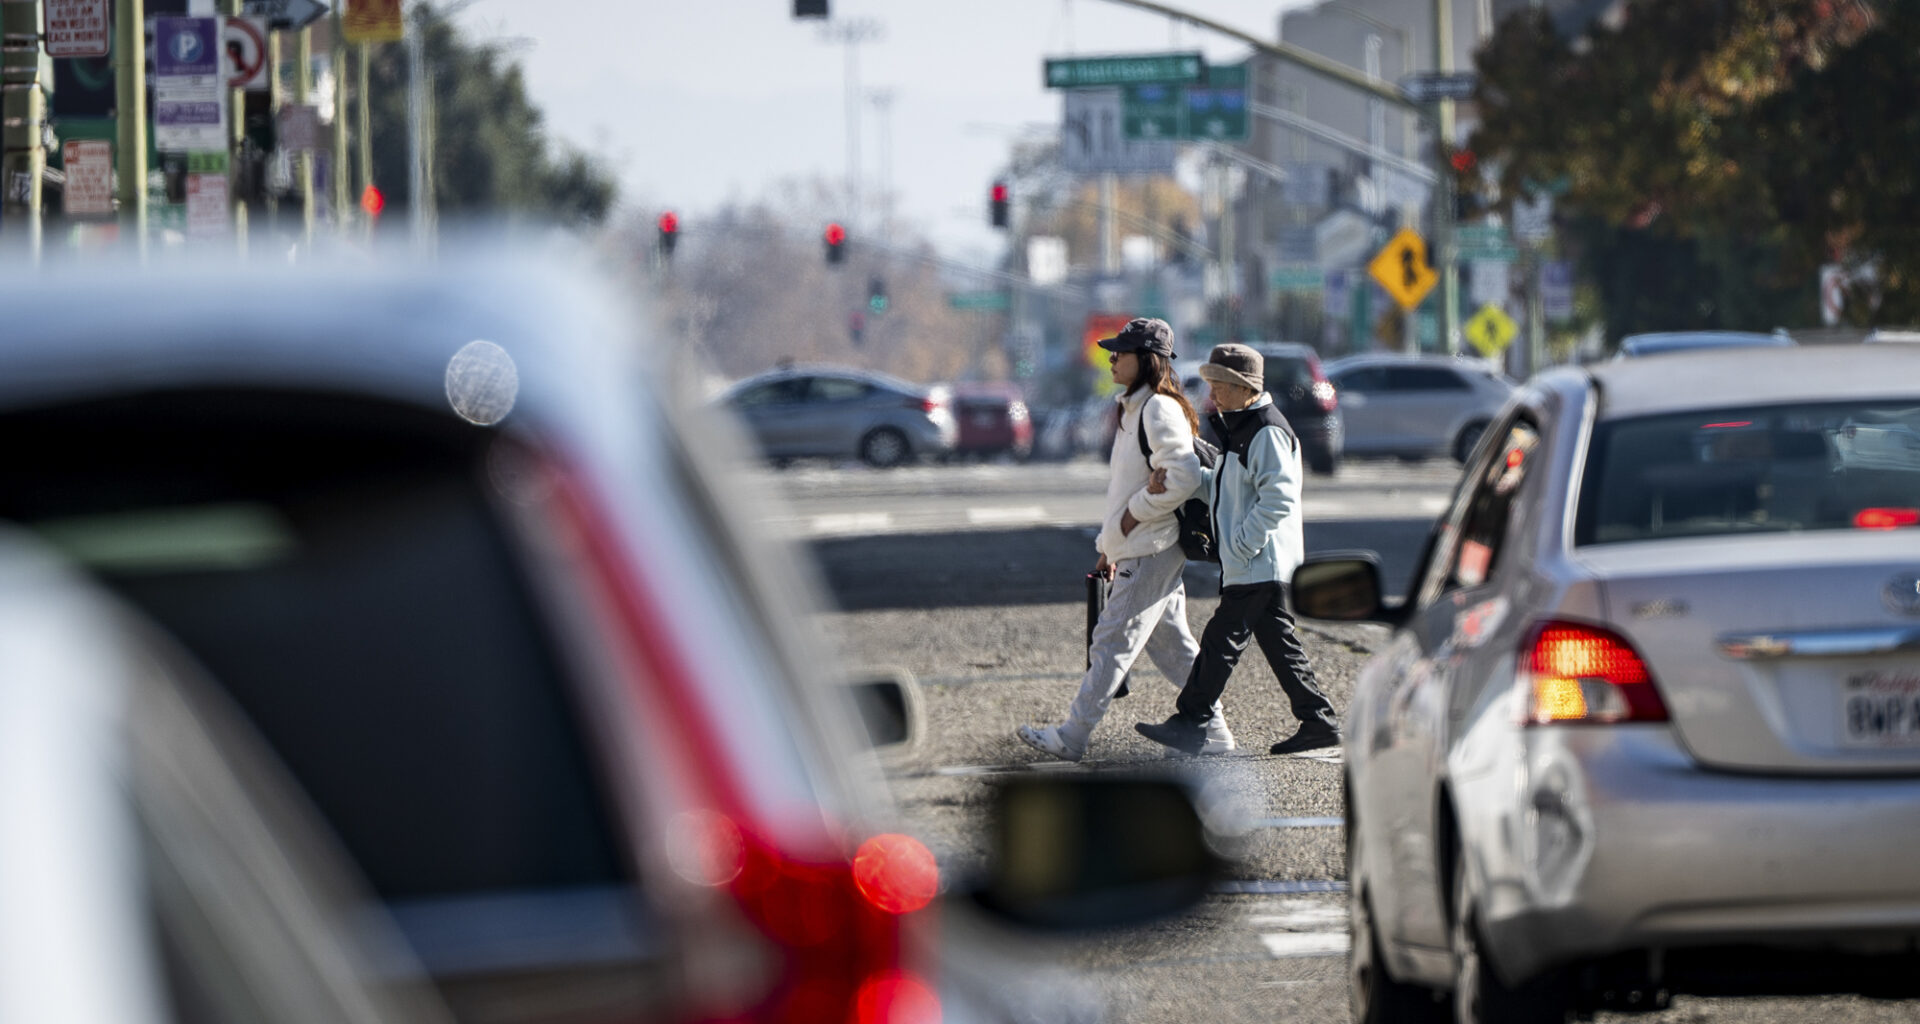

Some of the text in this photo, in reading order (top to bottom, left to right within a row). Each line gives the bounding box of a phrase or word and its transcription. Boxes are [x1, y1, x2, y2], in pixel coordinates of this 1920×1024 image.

[80, 6, 93, 15] AM
[50, 16, 100, 28] MON WED FRI
[49, 31, 104, 43] EACH MONTH
[178, 33, 197, 58] P
